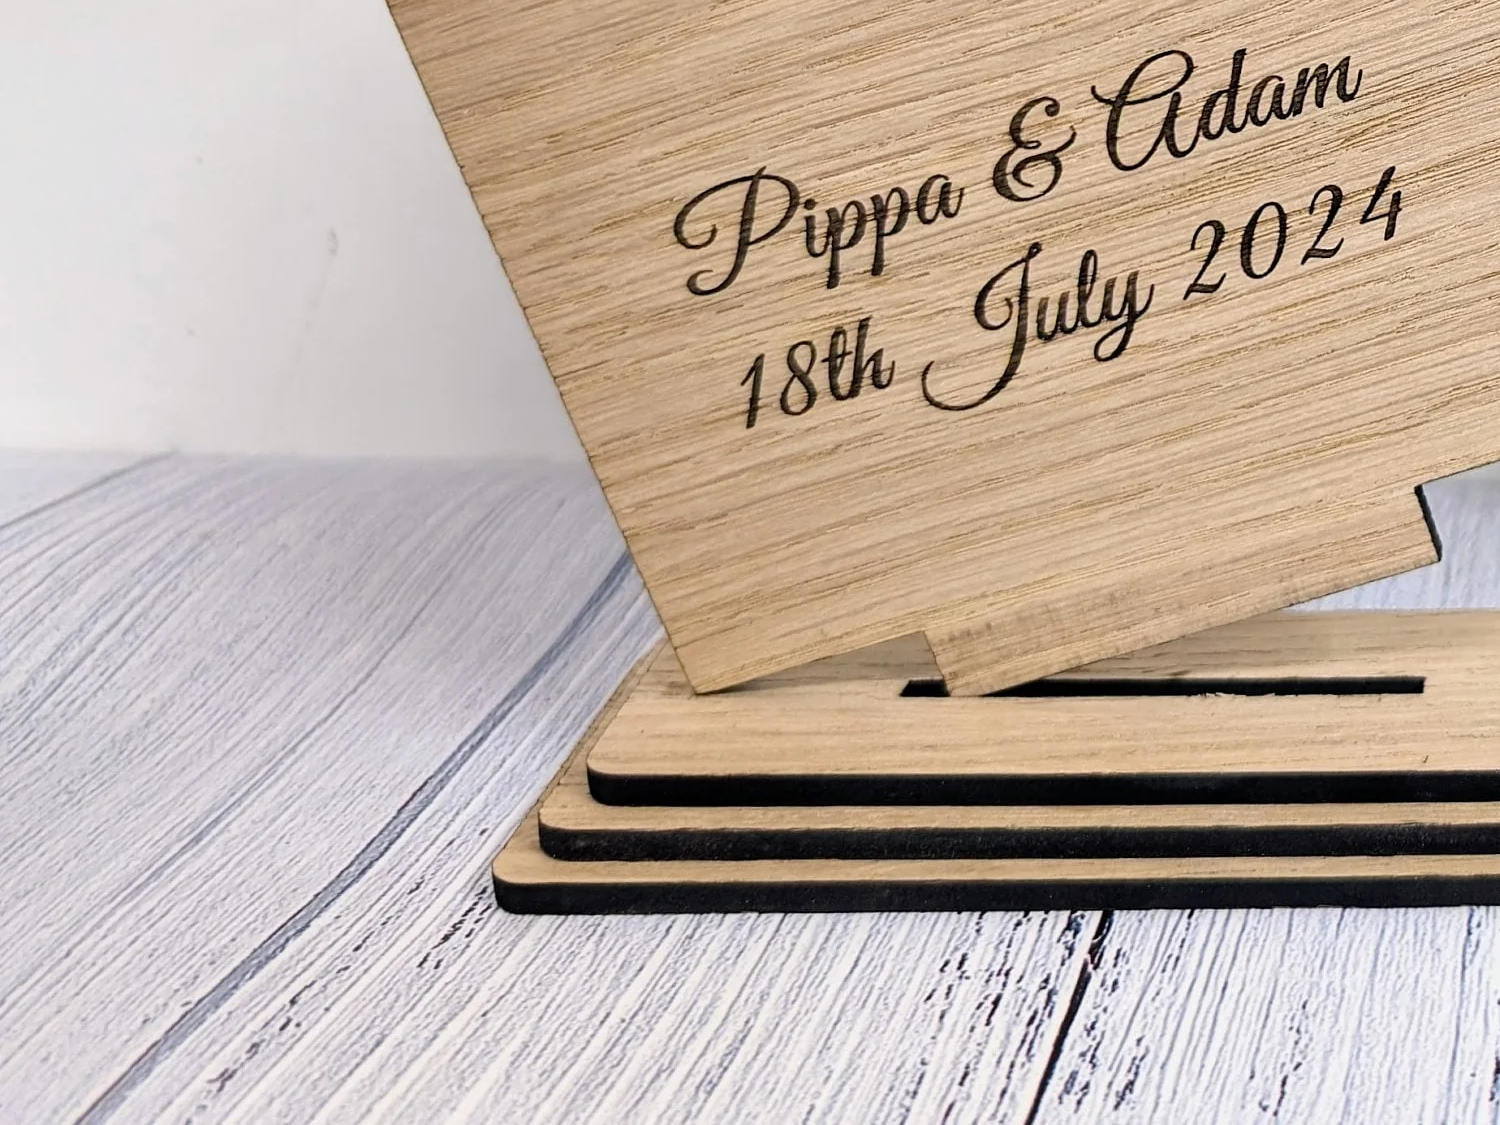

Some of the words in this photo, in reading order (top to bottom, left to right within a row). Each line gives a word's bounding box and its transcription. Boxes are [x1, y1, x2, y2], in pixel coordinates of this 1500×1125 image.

[672, 165, 966, 297] Pippa
[989, 95, 1078, 203] &
[1089, 47, 1364, 172] Adam
[739, 316, 896, 430] 18th
[920, 241, 1155, 412] July
[1181, 165, 1406, 301] 2024
